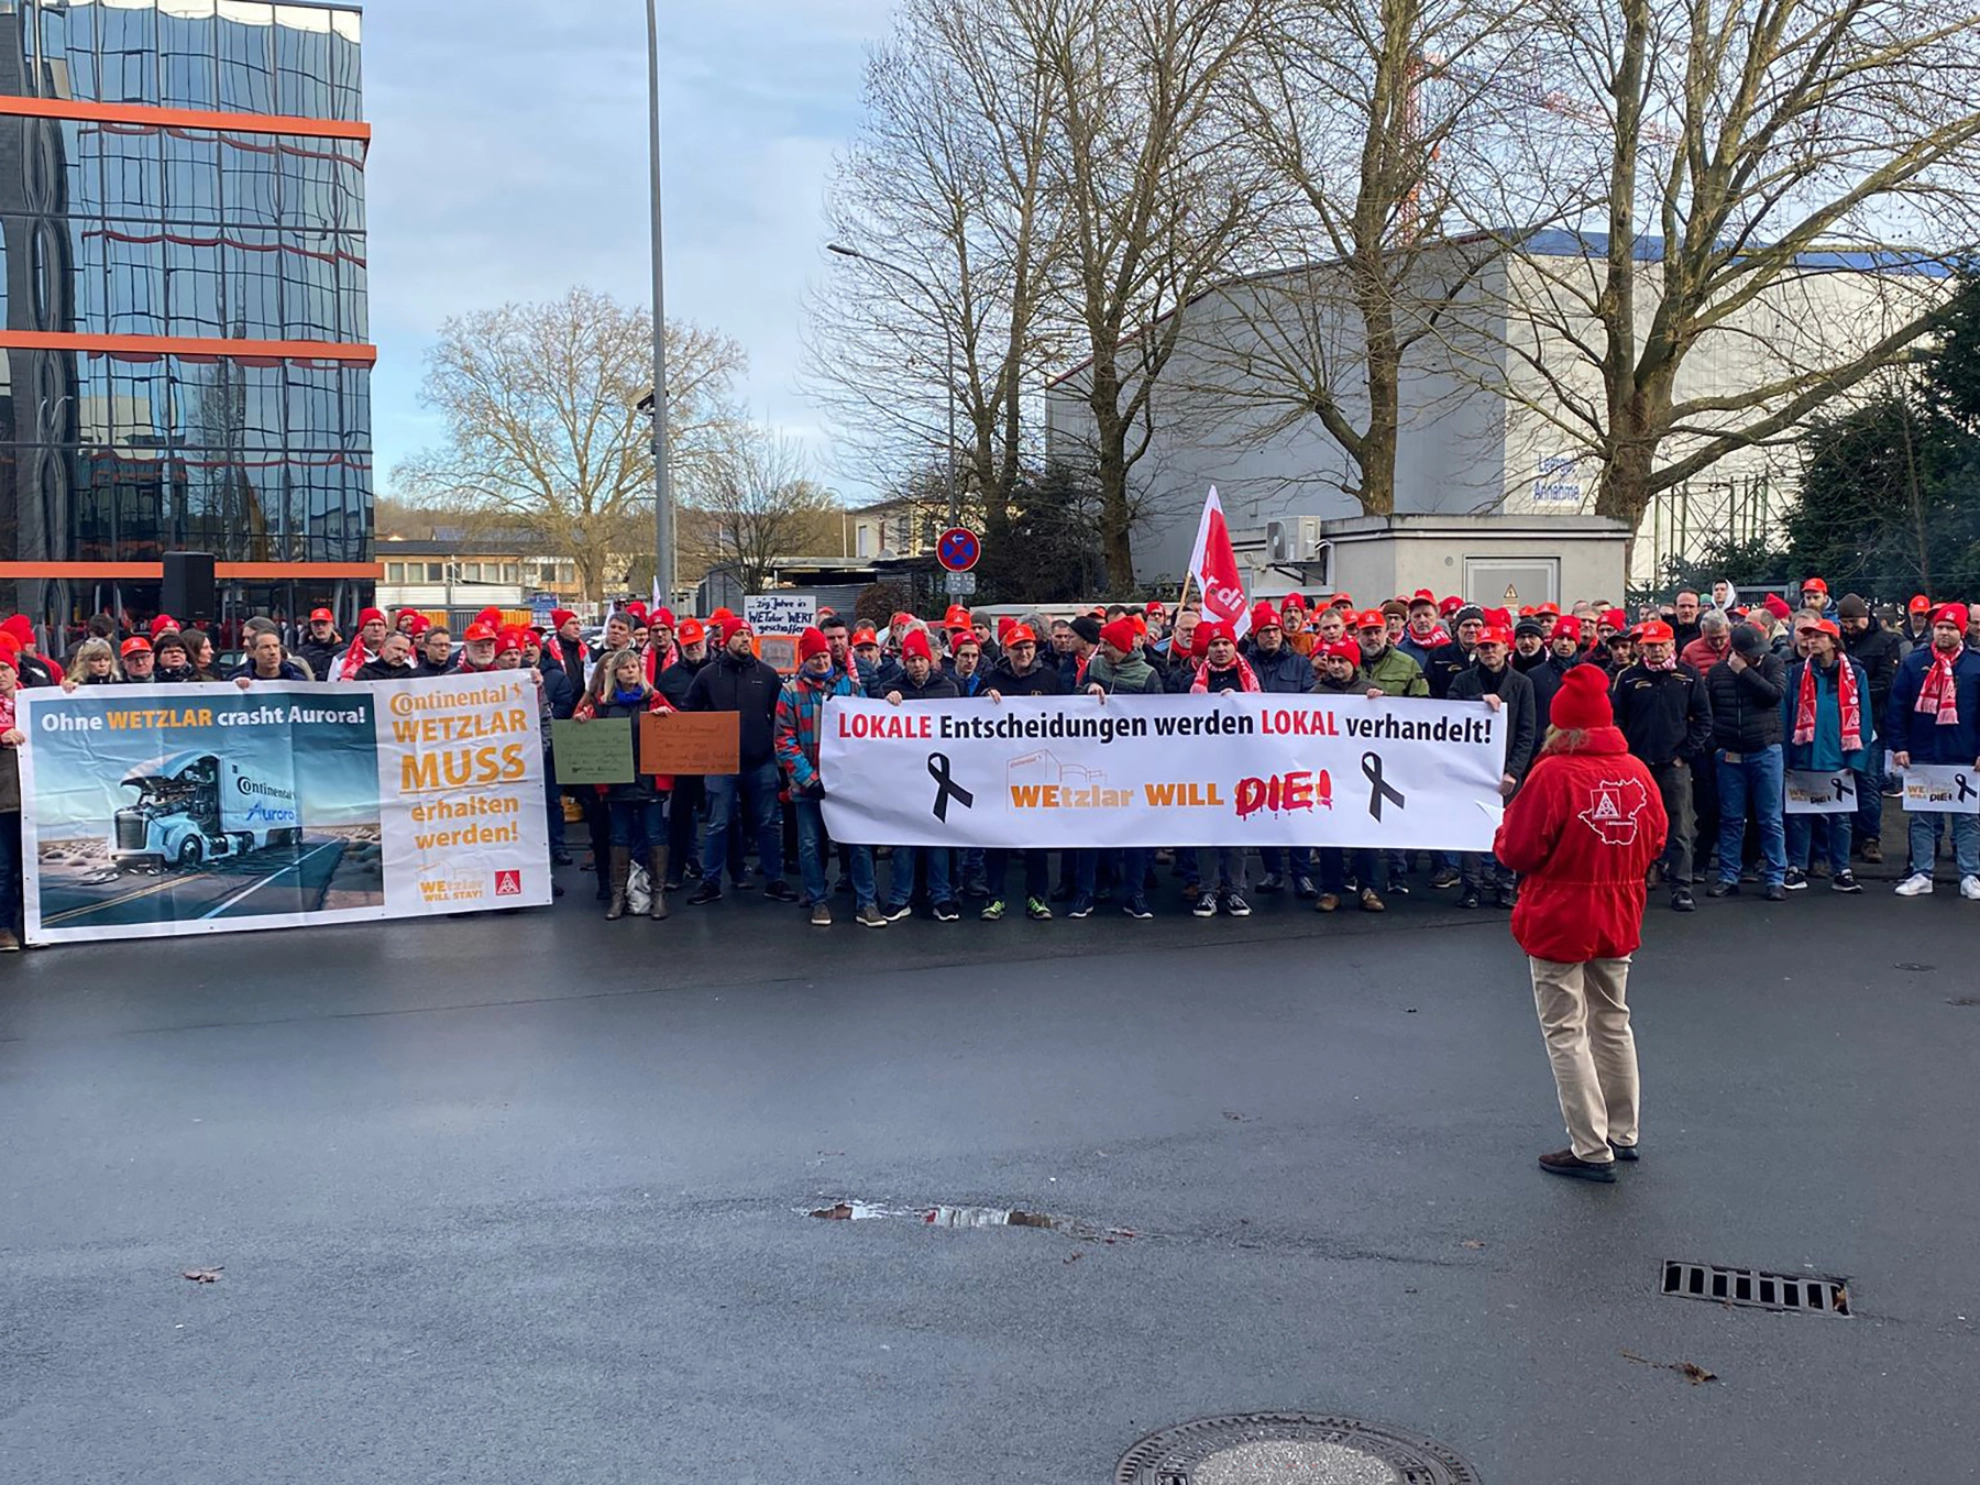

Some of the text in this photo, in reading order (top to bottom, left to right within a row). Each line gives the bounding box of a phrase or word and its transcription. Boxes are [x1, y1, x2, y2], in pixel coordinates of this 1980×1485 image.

[787, 611, 814, 623] WERT
[798, 598, 807, 608] in
[390, 684, 507, 717] Continental
[41, 705, 365, 732] Ohne WETZLAR crasht Aurora!
[392, 708, 528, 744] WETZLAR
[838, 708, 1492, 745] LOKALE Entscheidungen werden LOKAL verhandelt!
[401, 743, 526, 790] MUSS
[236, 776, 293, 800] Continental
[1010, 769, 1332, 818] WEtzlar WILL DIE!
[411, 795, 519, 822] erhalten
[414, 820, 519, 850] werden!
[424, 893, 451, 903] WILL
